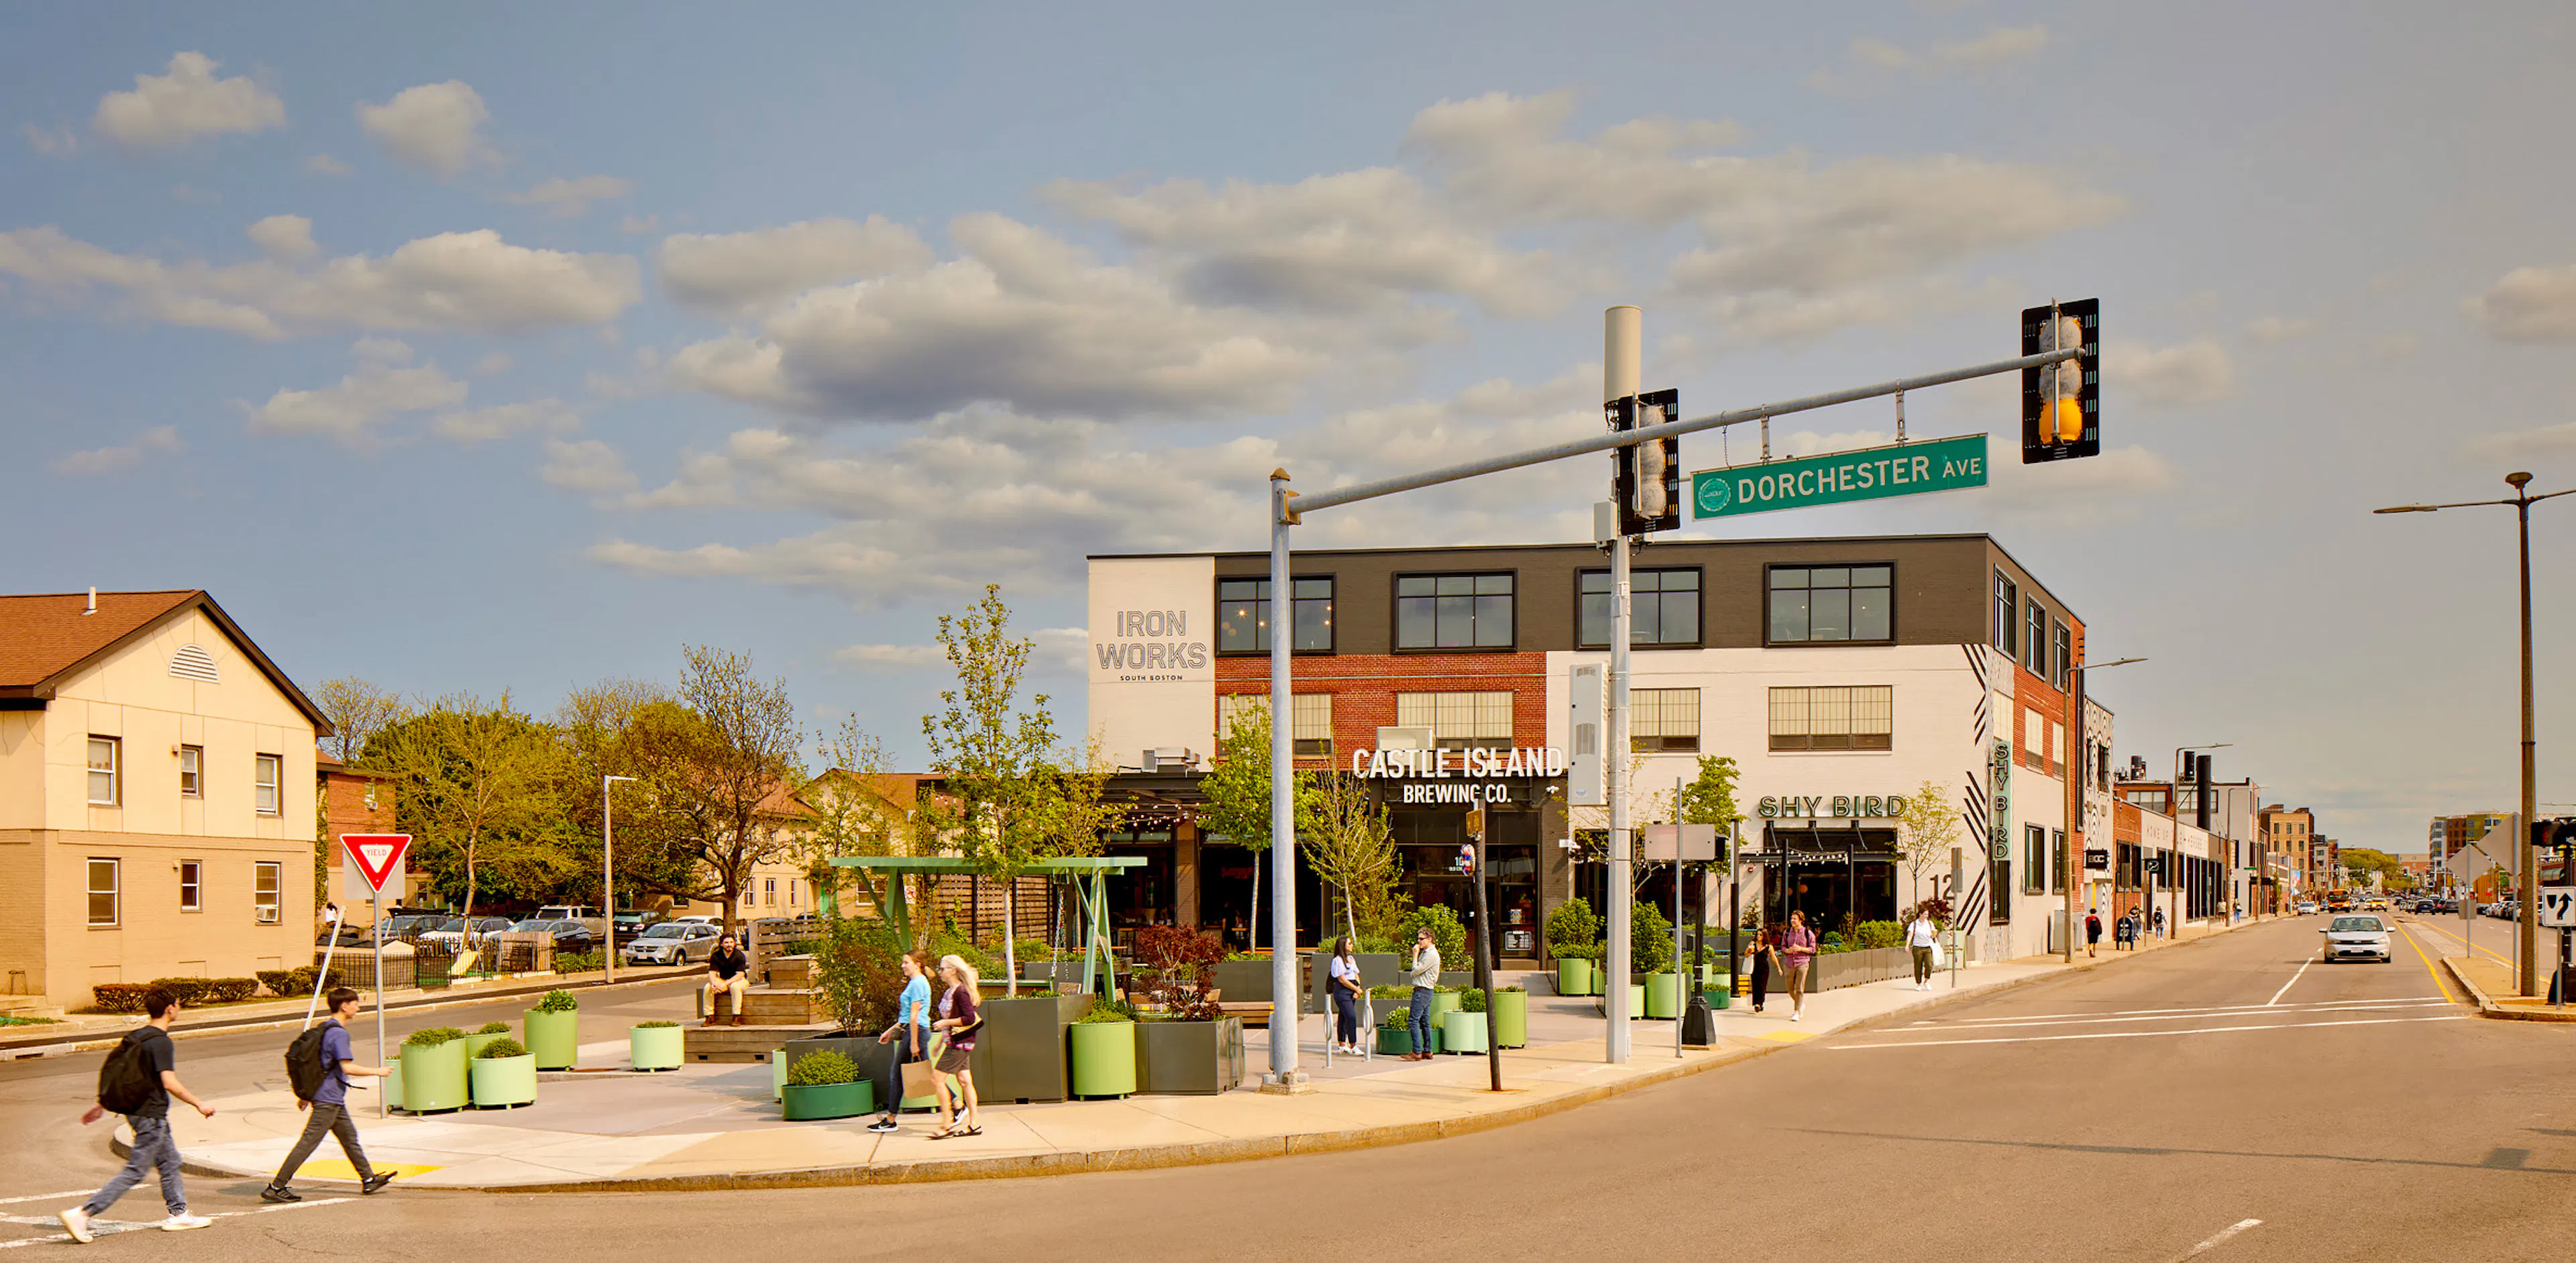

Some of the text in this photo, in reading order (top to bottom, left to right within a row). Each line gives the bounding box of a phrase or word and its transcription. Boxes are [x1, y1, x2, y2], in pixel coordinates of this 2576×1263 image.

[1738, 455, 1930, 504] DORCHESTER
[1943, 457, 1982, 478] AVE
[1117, 610, 1186, 637] IRON
[1096, 642, 1207, 669] WORKS
[1353, 746, 1563, 779] CASTLE ISLAND
[1995, 744, 2008, 791] SHY
[1403, 783, 1512, 804] BREWING CO.
[1758, 795, 1907, 817] SHY BIRD
[1994, 795, 2008, 858] BIRD
[1929, 874, 1955, 900] 12
